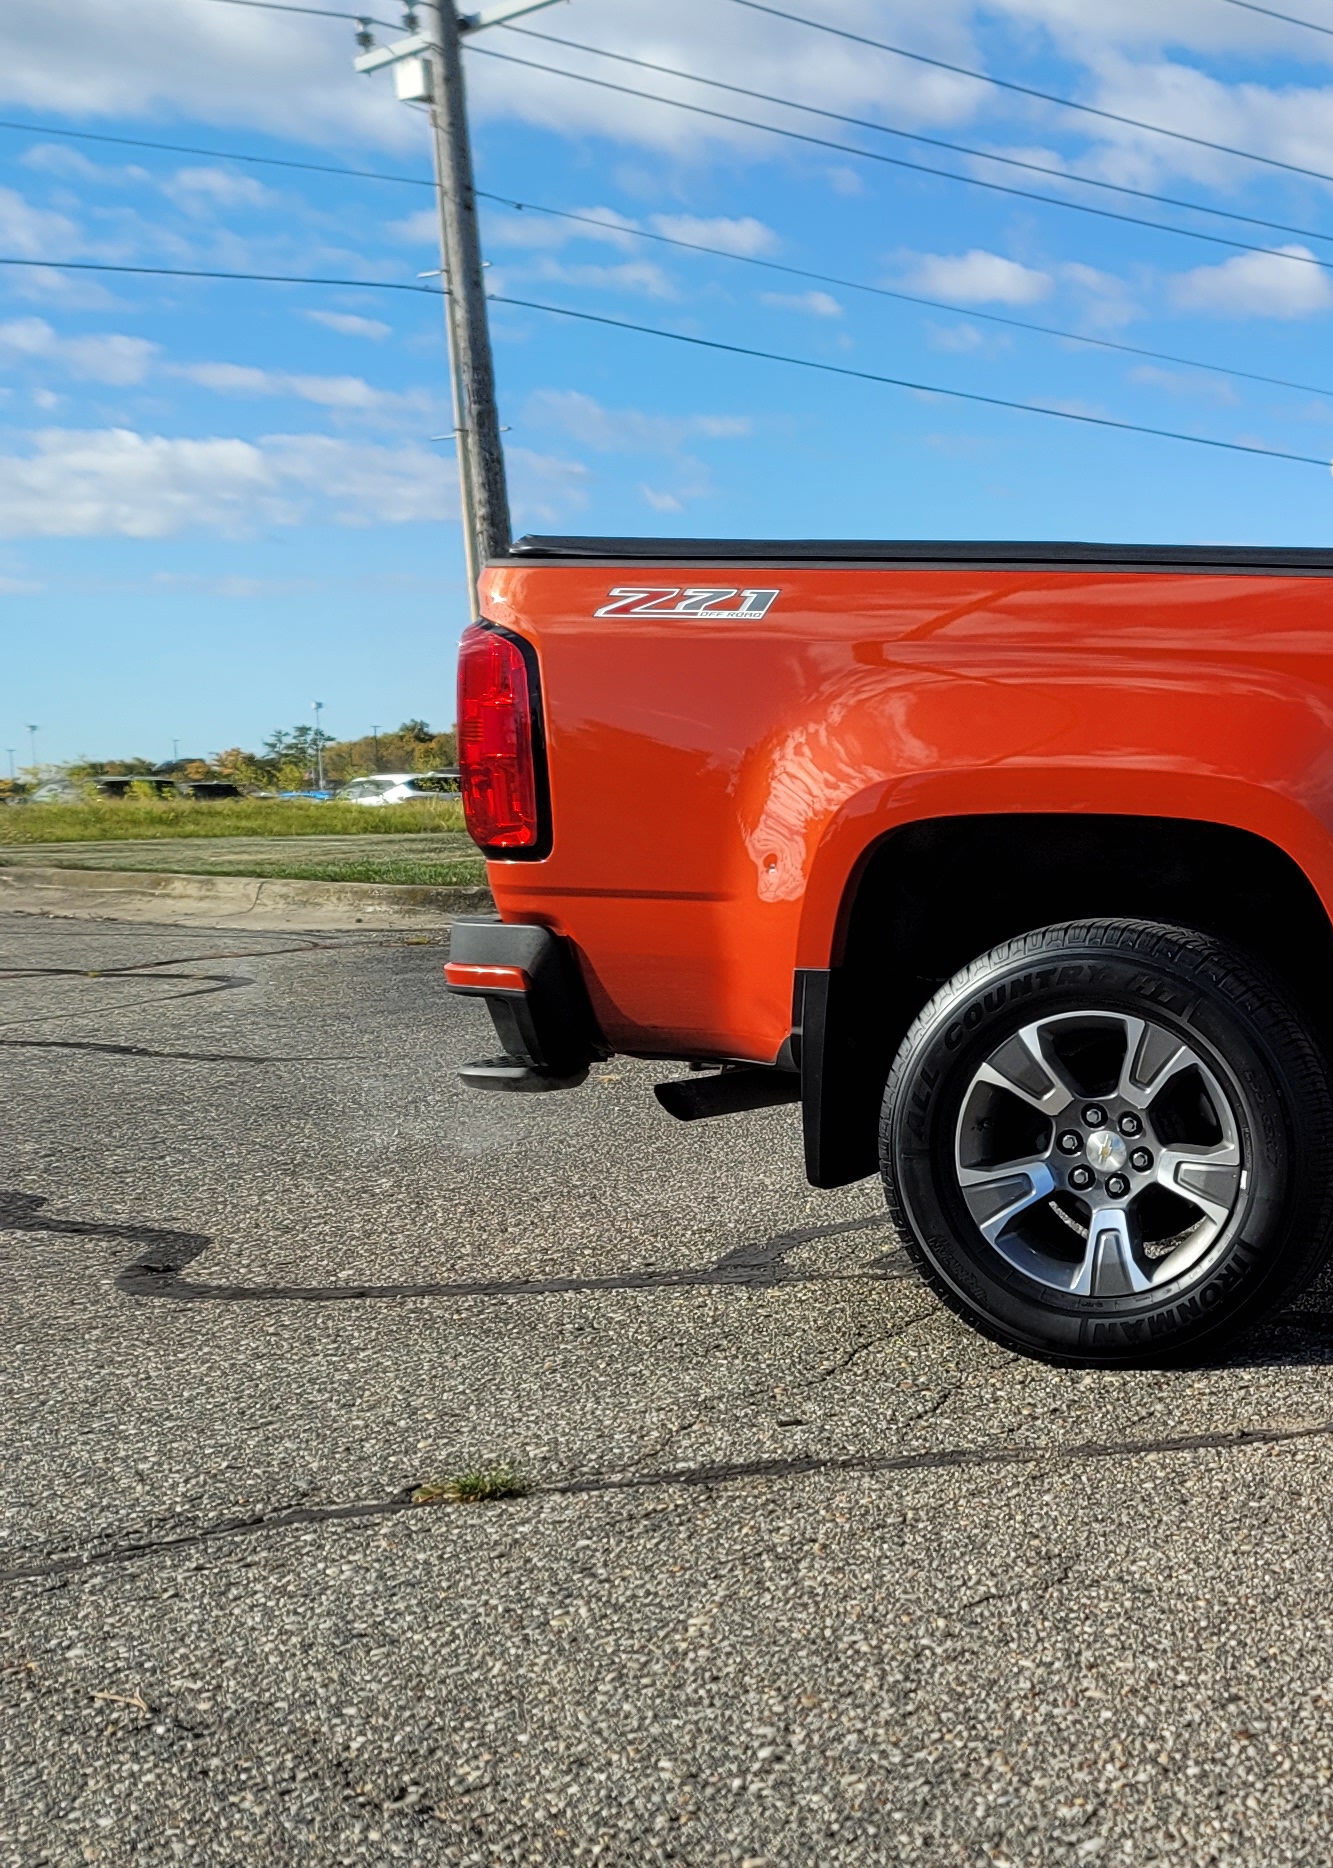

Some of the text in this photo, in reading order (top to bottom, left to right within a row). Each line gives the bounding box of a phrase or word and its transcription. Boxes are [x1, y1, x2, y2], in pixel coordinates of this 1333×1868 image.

[592, 587, 781, 620] Z71
[698, 611, 763, 619] OFF ROAD
[944, 964, 1112, 1051] COUNTRY
[1092, 1242, 1253, 1345] IRONMAN
